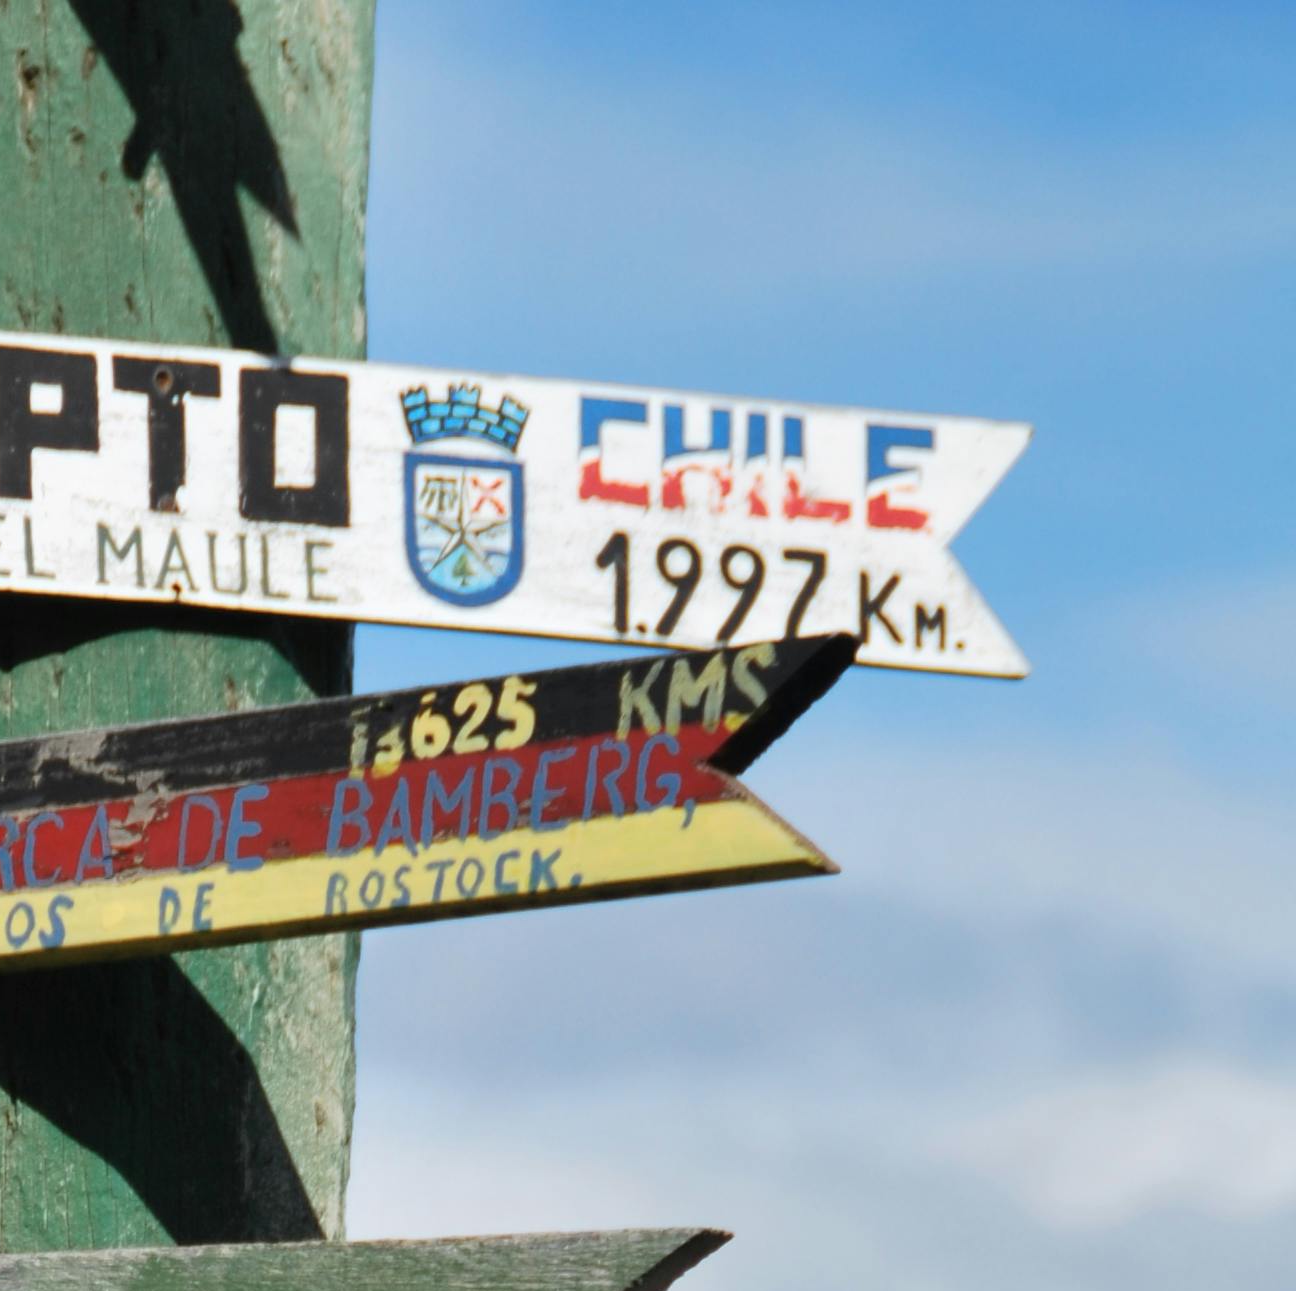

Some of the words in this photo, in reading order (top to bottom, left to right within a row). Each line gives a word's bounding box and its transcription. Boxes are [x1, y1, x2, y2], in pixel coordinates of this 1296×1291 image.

[579, 396, 935, 533] CHILE
[94, 524, 339, 604] MAULE
[596, 532, 826, 641] 1.997
[616, 641, 779, 741] KMS
[178, 783, 269, 873] DE
[158, 883, 214, 935] DE
